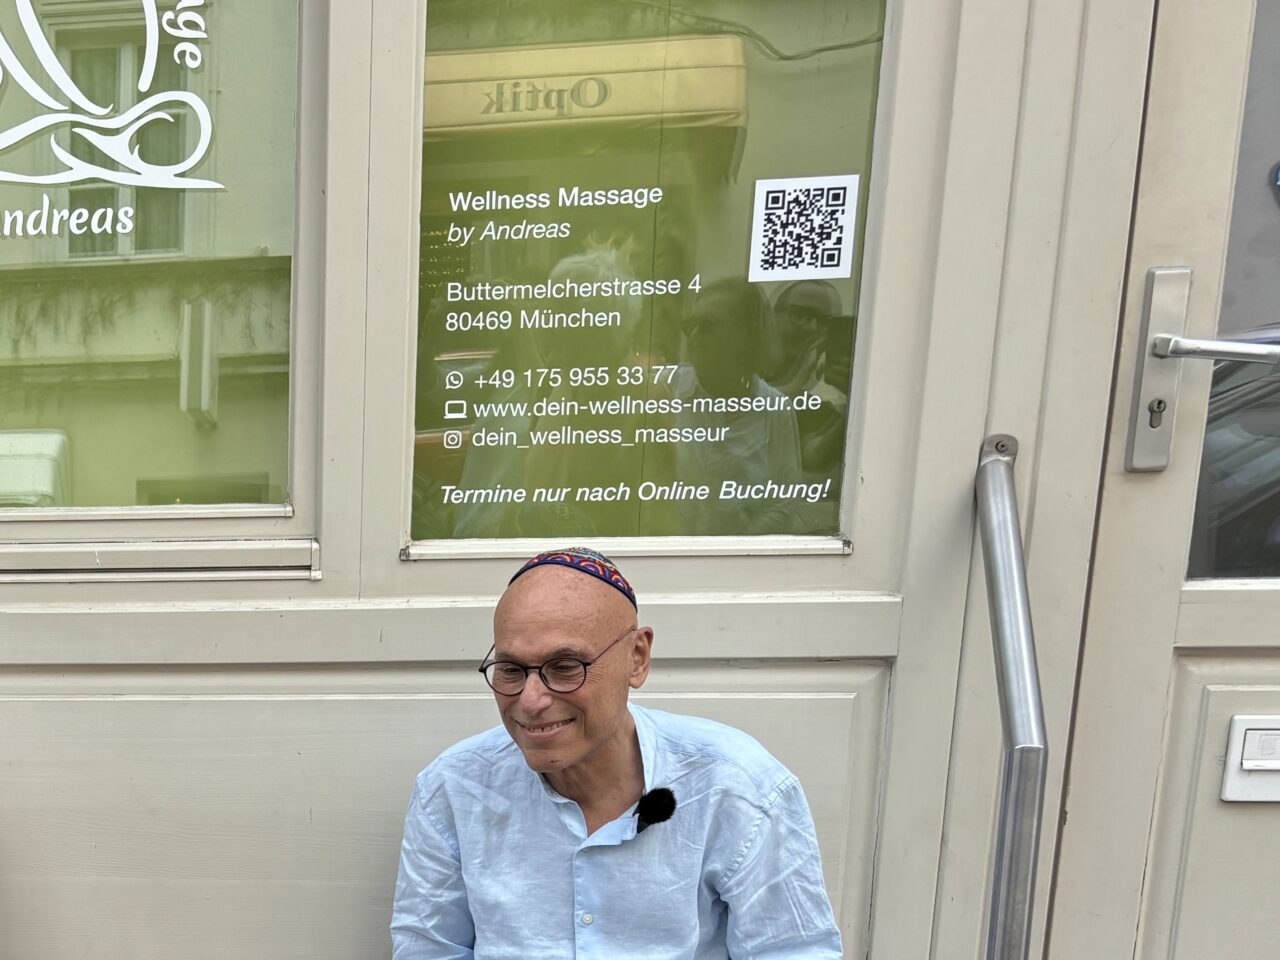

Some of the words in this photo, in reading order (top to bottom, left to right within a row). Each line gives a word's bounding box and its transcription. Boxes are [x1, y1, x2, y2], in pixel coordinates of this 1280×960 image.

[449, 190, 551, 212] Wellness
[558, 186, 663, 209] Massage
[447, 222, 475, 244] by
[480, 219, 571, 241] Andreas
[447, 277, 681, 302] Buttermelcherstrasse
[687, 273, 702, 294] 4
[445, 310, 512, 331] 80469
[520, 308, 621, 330] München
[474, 369, 515, 389] +49
[523, 368, 562, 388] 175
[569, 366, 609, 387] 955
[616, 365, 644, 386] 33
[652, 365, 679, 384] 77
[473, 391, 821, 417] www.dein-wellness-masseur.de
[472, 425, 730, 448] dein_wellness_masseur
[441, 484, 527, 504] Termine
[532, 486, 571, 502] nur
[575, 482, 631, 502] nach
[638, 480, 710, 501] Online
[718, 478, 832, 503] Buchung!
